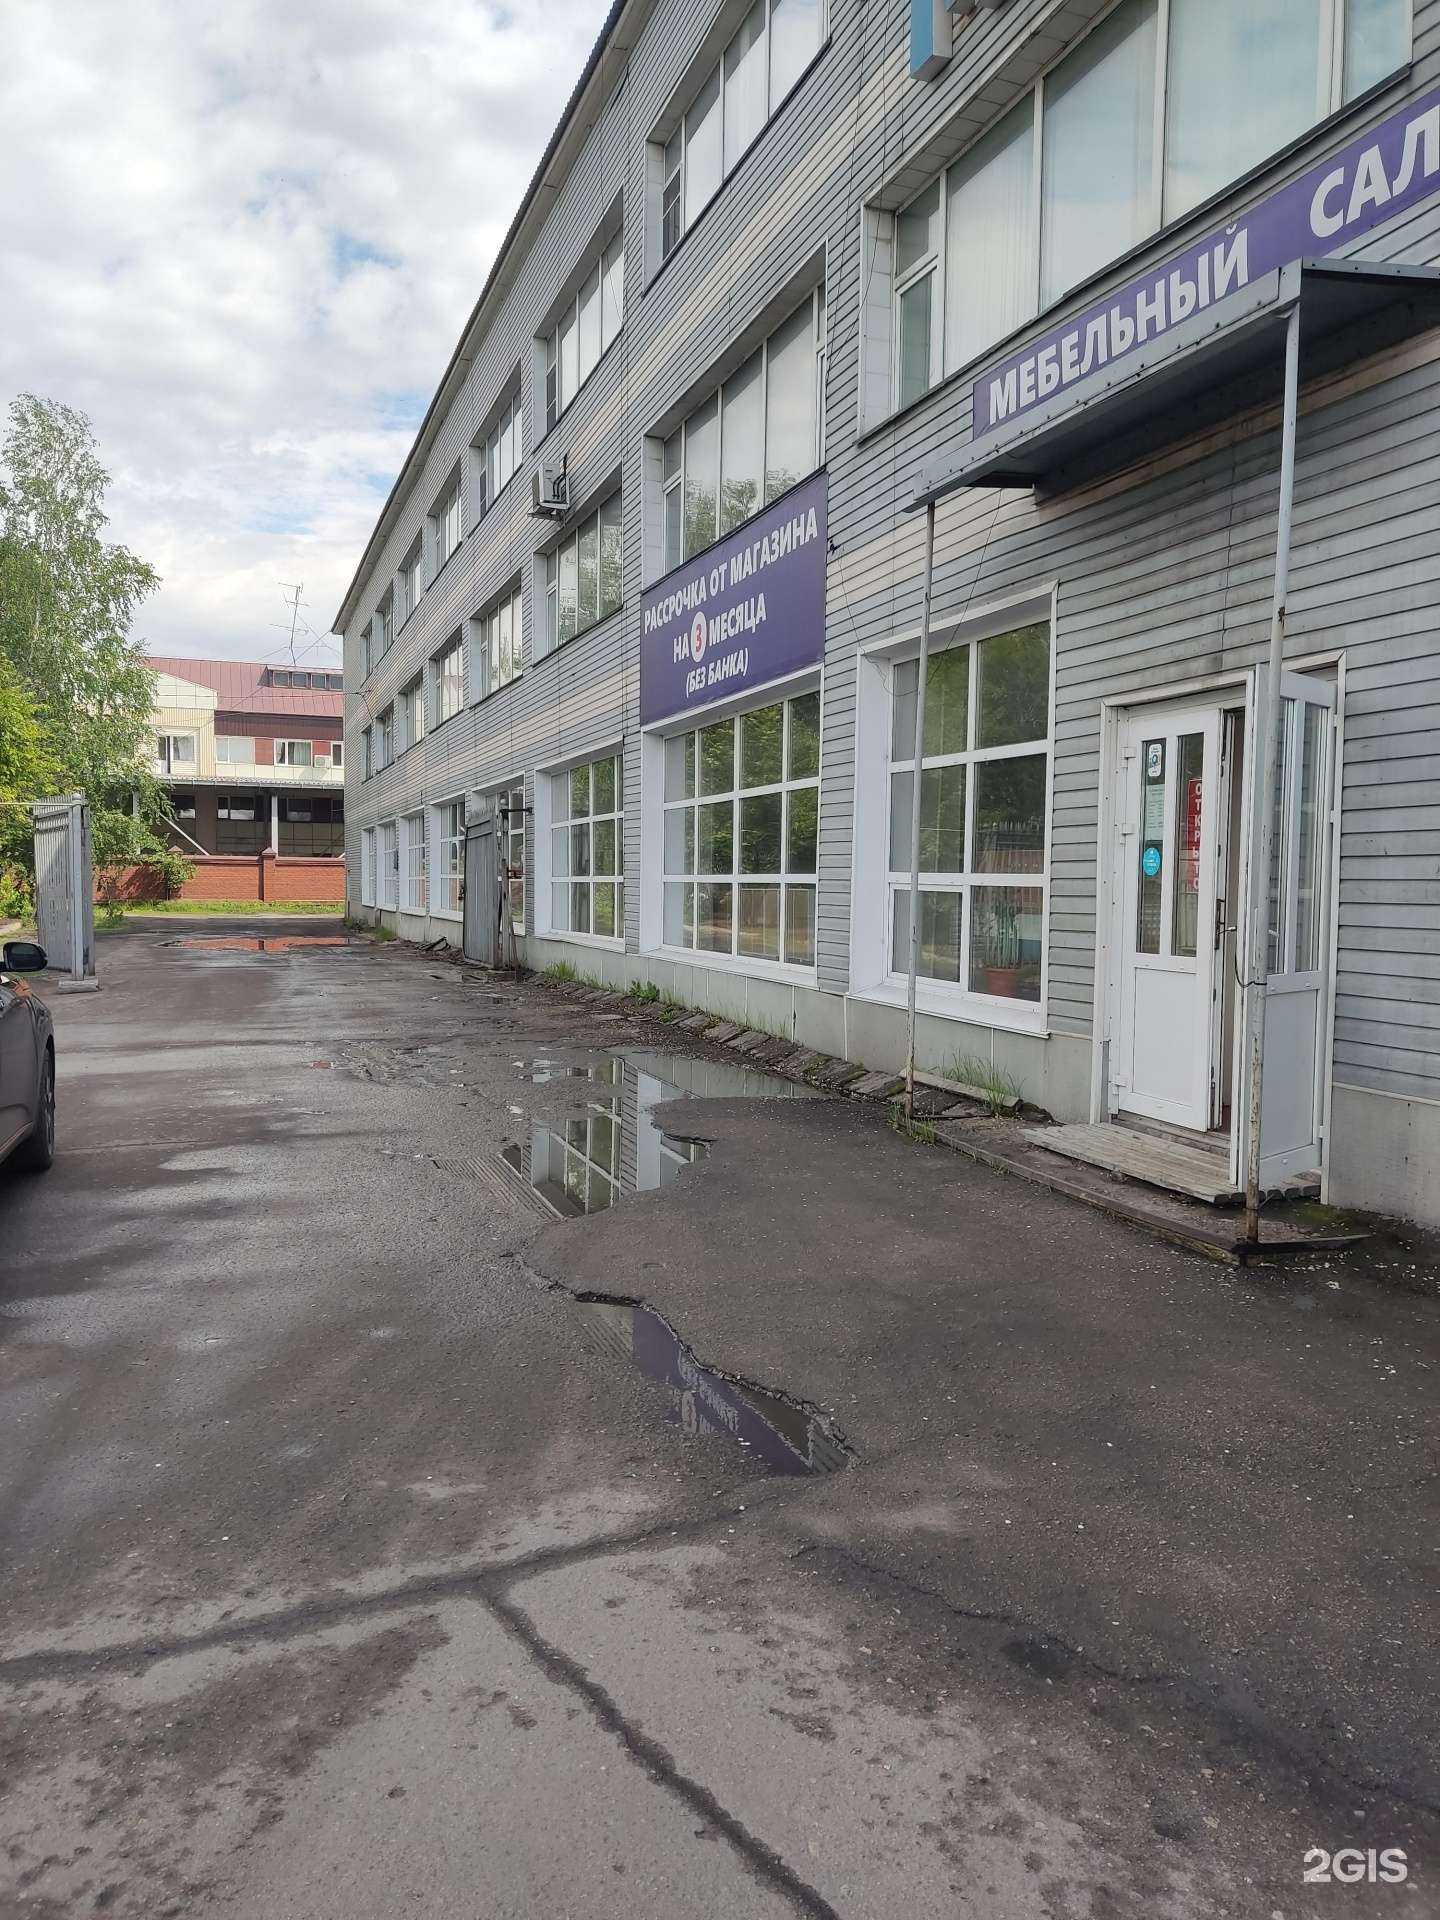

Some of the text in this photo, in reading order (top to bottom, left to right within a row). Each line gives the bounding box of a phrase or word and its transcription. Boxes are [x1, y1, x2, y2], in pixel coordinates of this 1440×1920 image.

[989, 104, 1440, 425] МЕБЕЛЬНЫЙ САЛ
[644, 506, 818, 635] РАССРОЧКА ОТ МАГАЗИНА
[673, 632, 690, 663] НА
[709, 592, 767, 646] МЕСЯЦА
[686, 647, 749, 698] (БЕЗ БАНКА)
